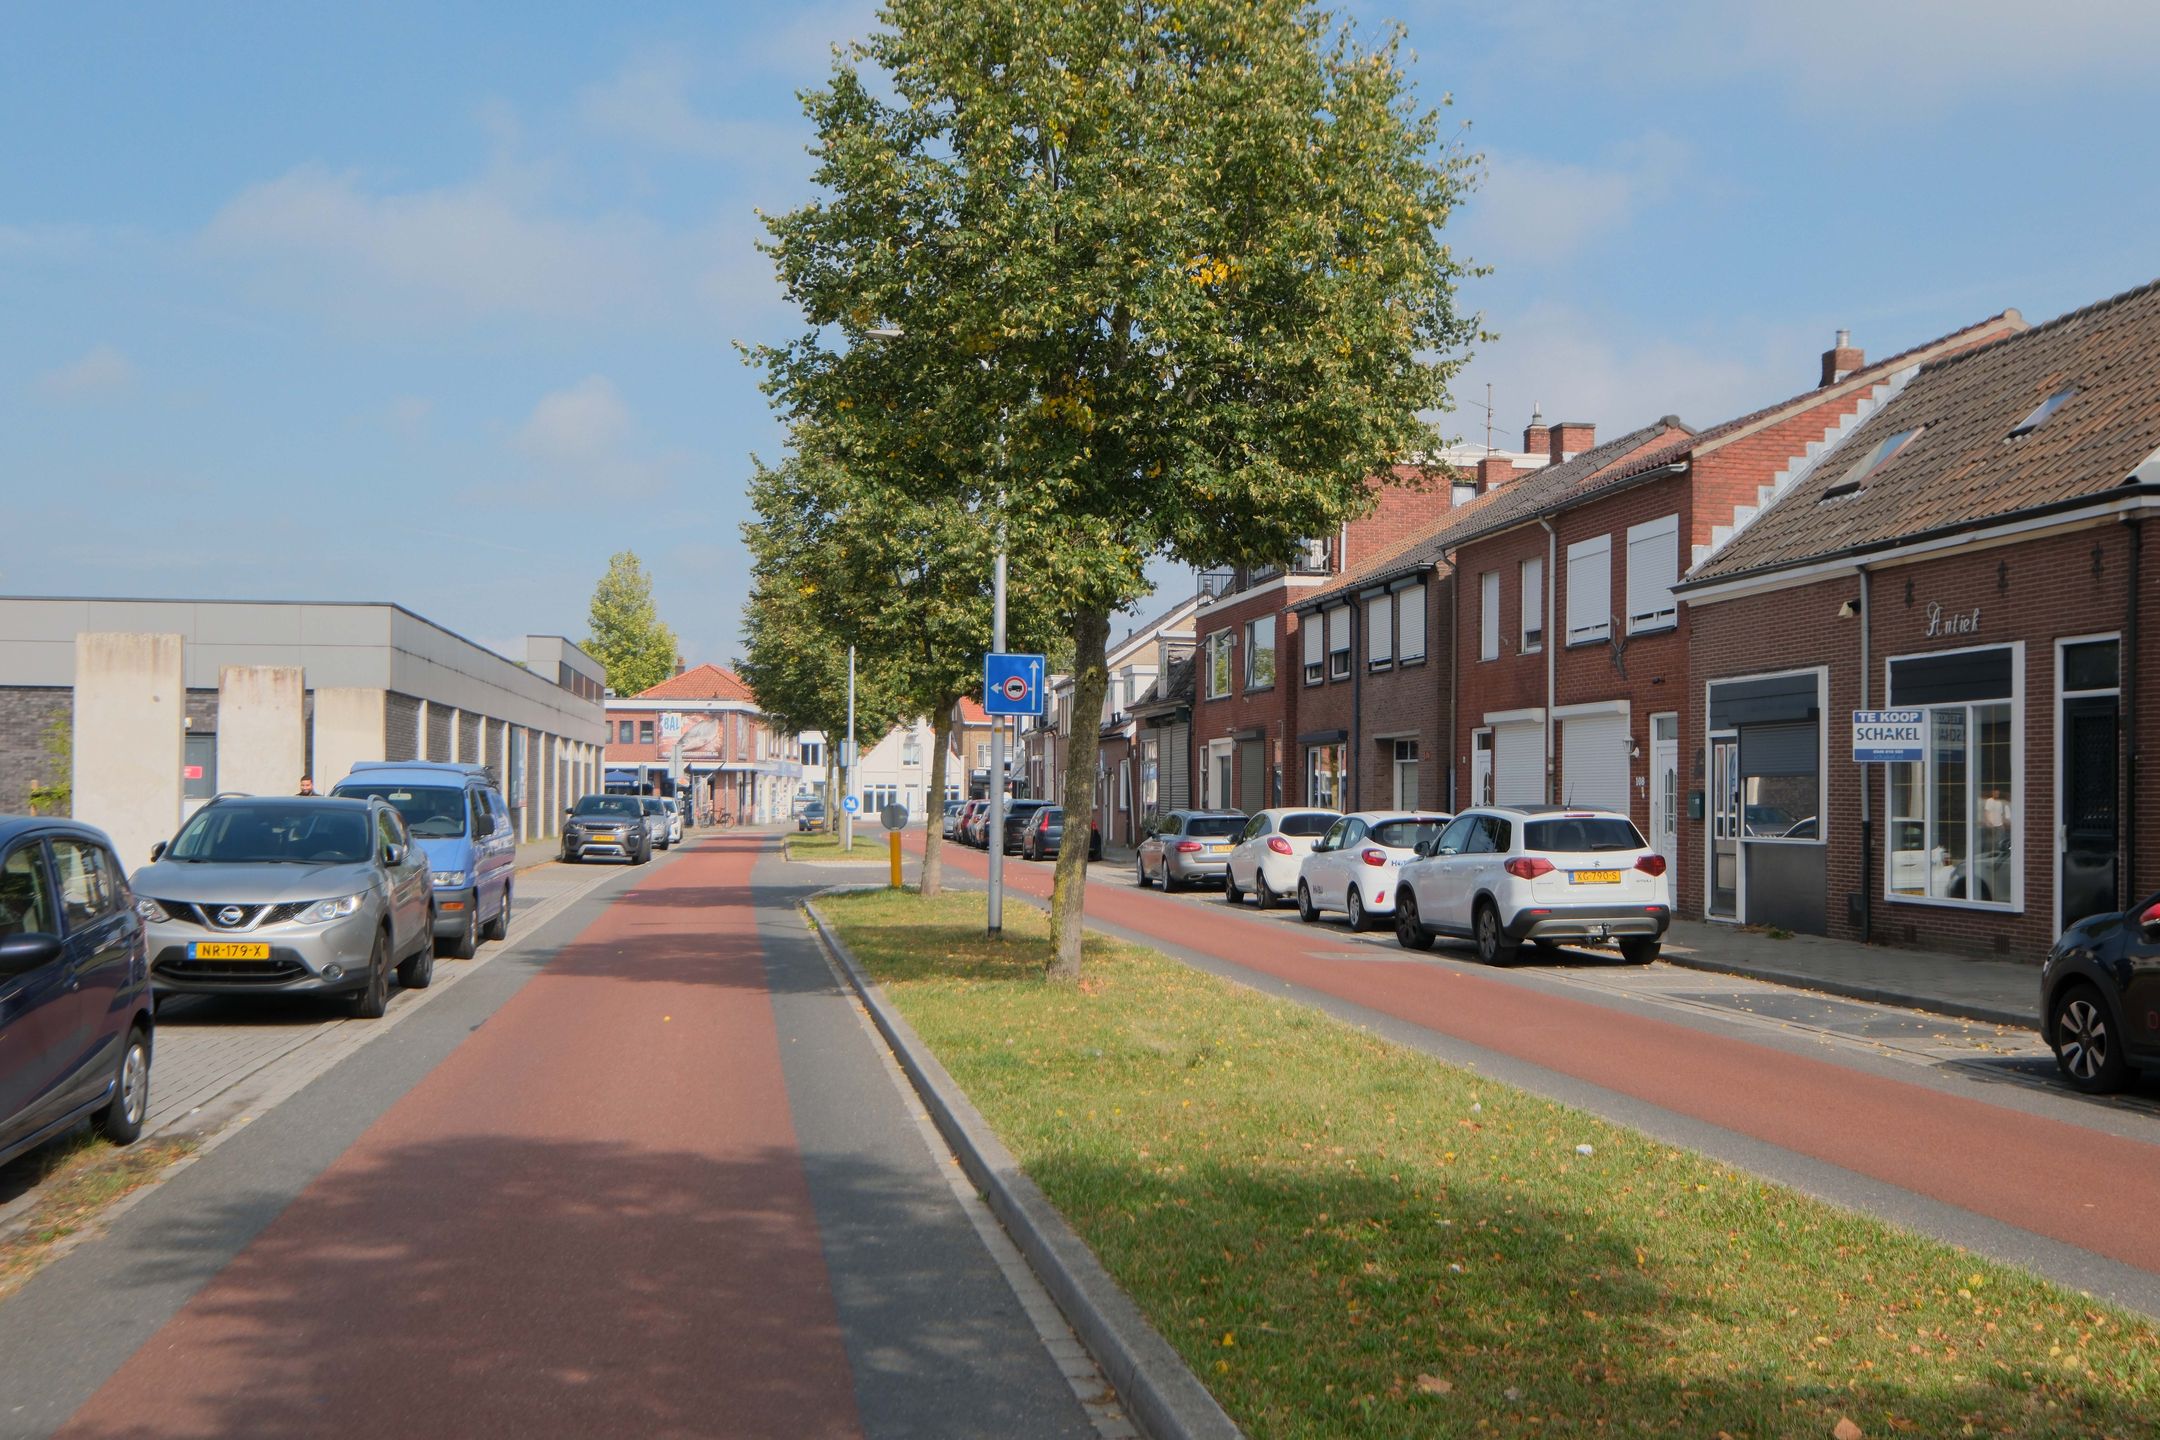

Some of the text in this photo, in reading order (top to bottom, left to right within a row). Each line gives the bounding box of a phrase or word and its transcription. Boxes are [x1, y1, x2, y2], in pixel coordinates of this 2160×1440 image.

[1926, 601, 1980, 636] Antiek
[1858, 712, 1919, 722] TE KOOP
[1856, 727, 1920, 741] SCHAKEL
[1576, 871, 1617, 881] XG-790-S
[202, 945, 262, 957] NR-179-X
